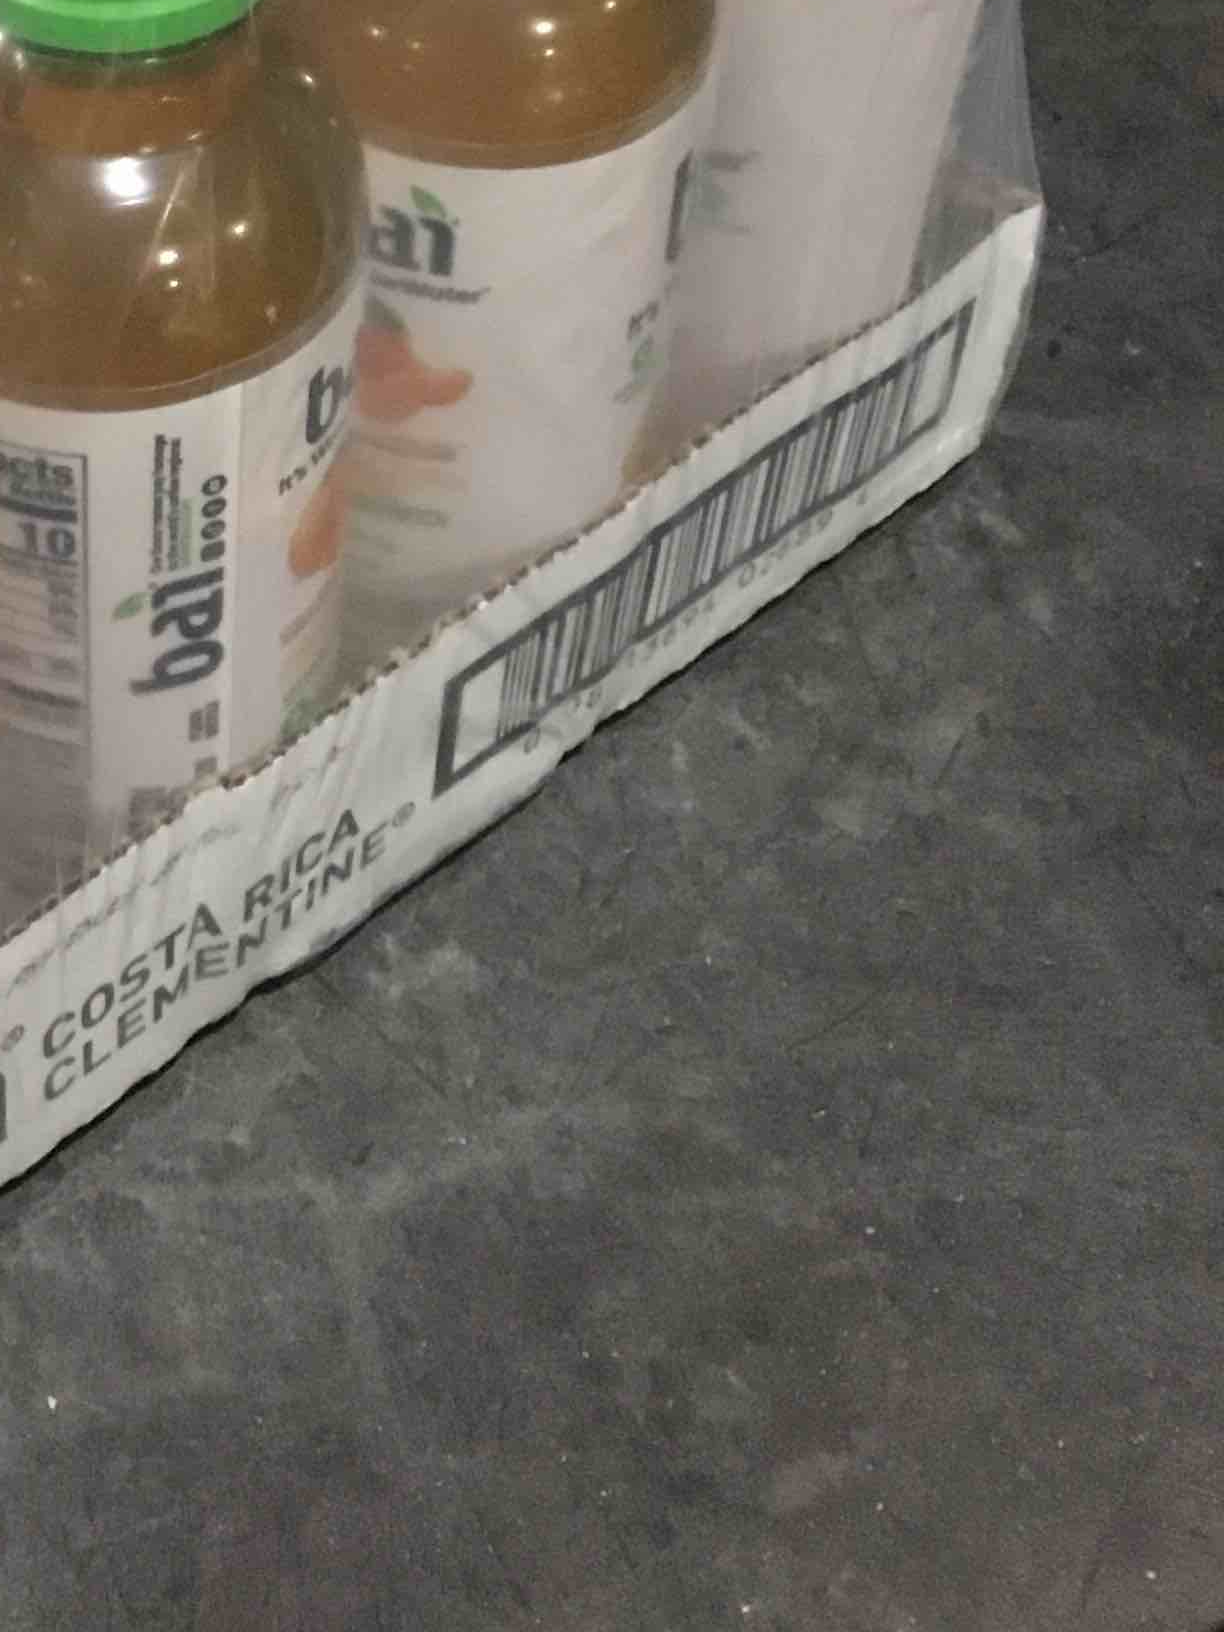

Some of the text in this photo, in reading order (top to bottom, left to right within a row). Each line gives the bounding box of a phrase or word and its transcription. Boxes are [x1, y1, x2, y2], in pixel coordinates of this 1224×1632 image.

[362, 202, 457, 276] ai
[18, 520, 75, 561] 10
[130, 565, 224, 696] bai
[42, 902, 224, 1061] COSTA
[243, 808, 362, 924] RICA
[43, 825, 387, 1102] CLEMENTINE
